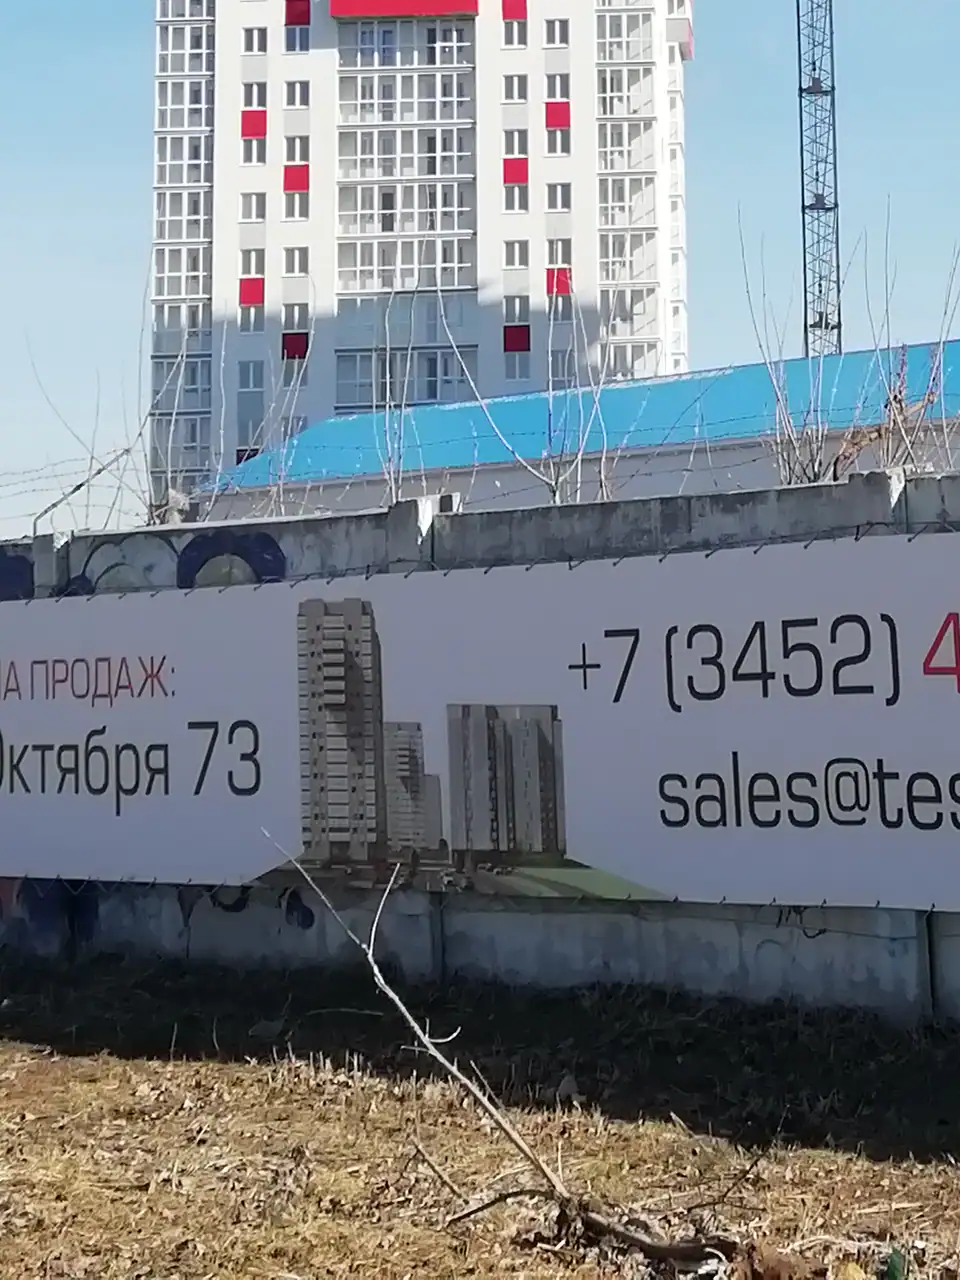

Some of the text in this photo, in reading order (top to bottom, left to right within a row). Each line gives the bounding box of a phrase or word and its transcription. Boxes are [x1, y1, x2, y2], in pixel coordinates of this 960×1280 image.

[0, 655, 176, 708] А ПРОДАЖ:
[567, 627, 640, 704] +7
[665, 612, 901, 714] (3452)
[0, 719, 261, 817] ктября 73
